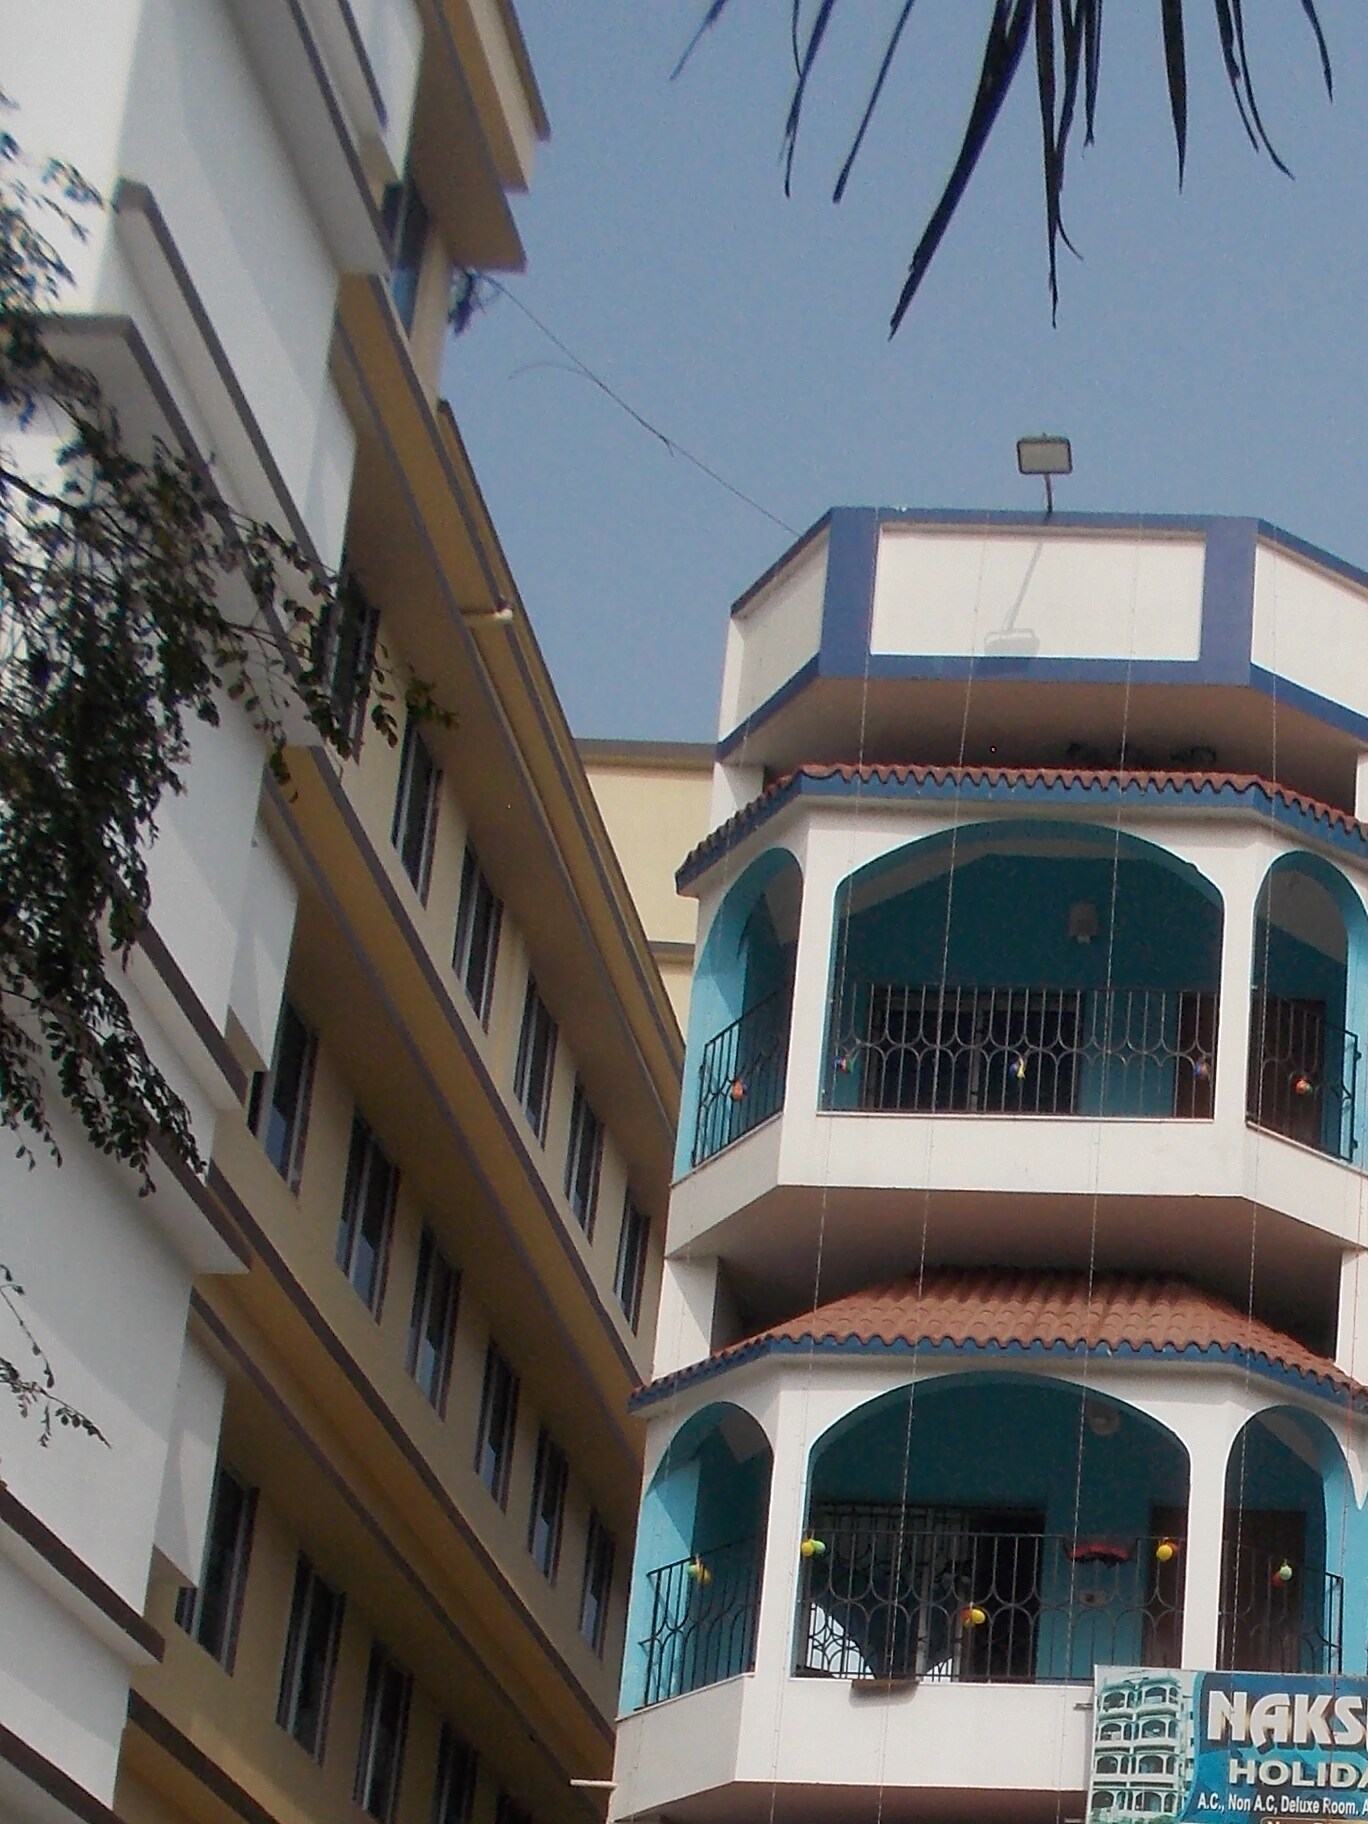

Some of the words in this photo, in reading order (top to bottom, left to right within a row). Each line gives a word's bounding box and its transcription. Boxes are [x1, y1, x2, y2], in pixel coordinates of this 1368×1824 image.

[1198, 1793, 1224, 1813] A.C.,
[1228, 1795, 1250, 1811] Non
[1254, 1795, 1277, 1815] A.C,
[1281, 1796, 1319, 1814] Deluxe
[1323, 1798, 1359, 1815] Room.
